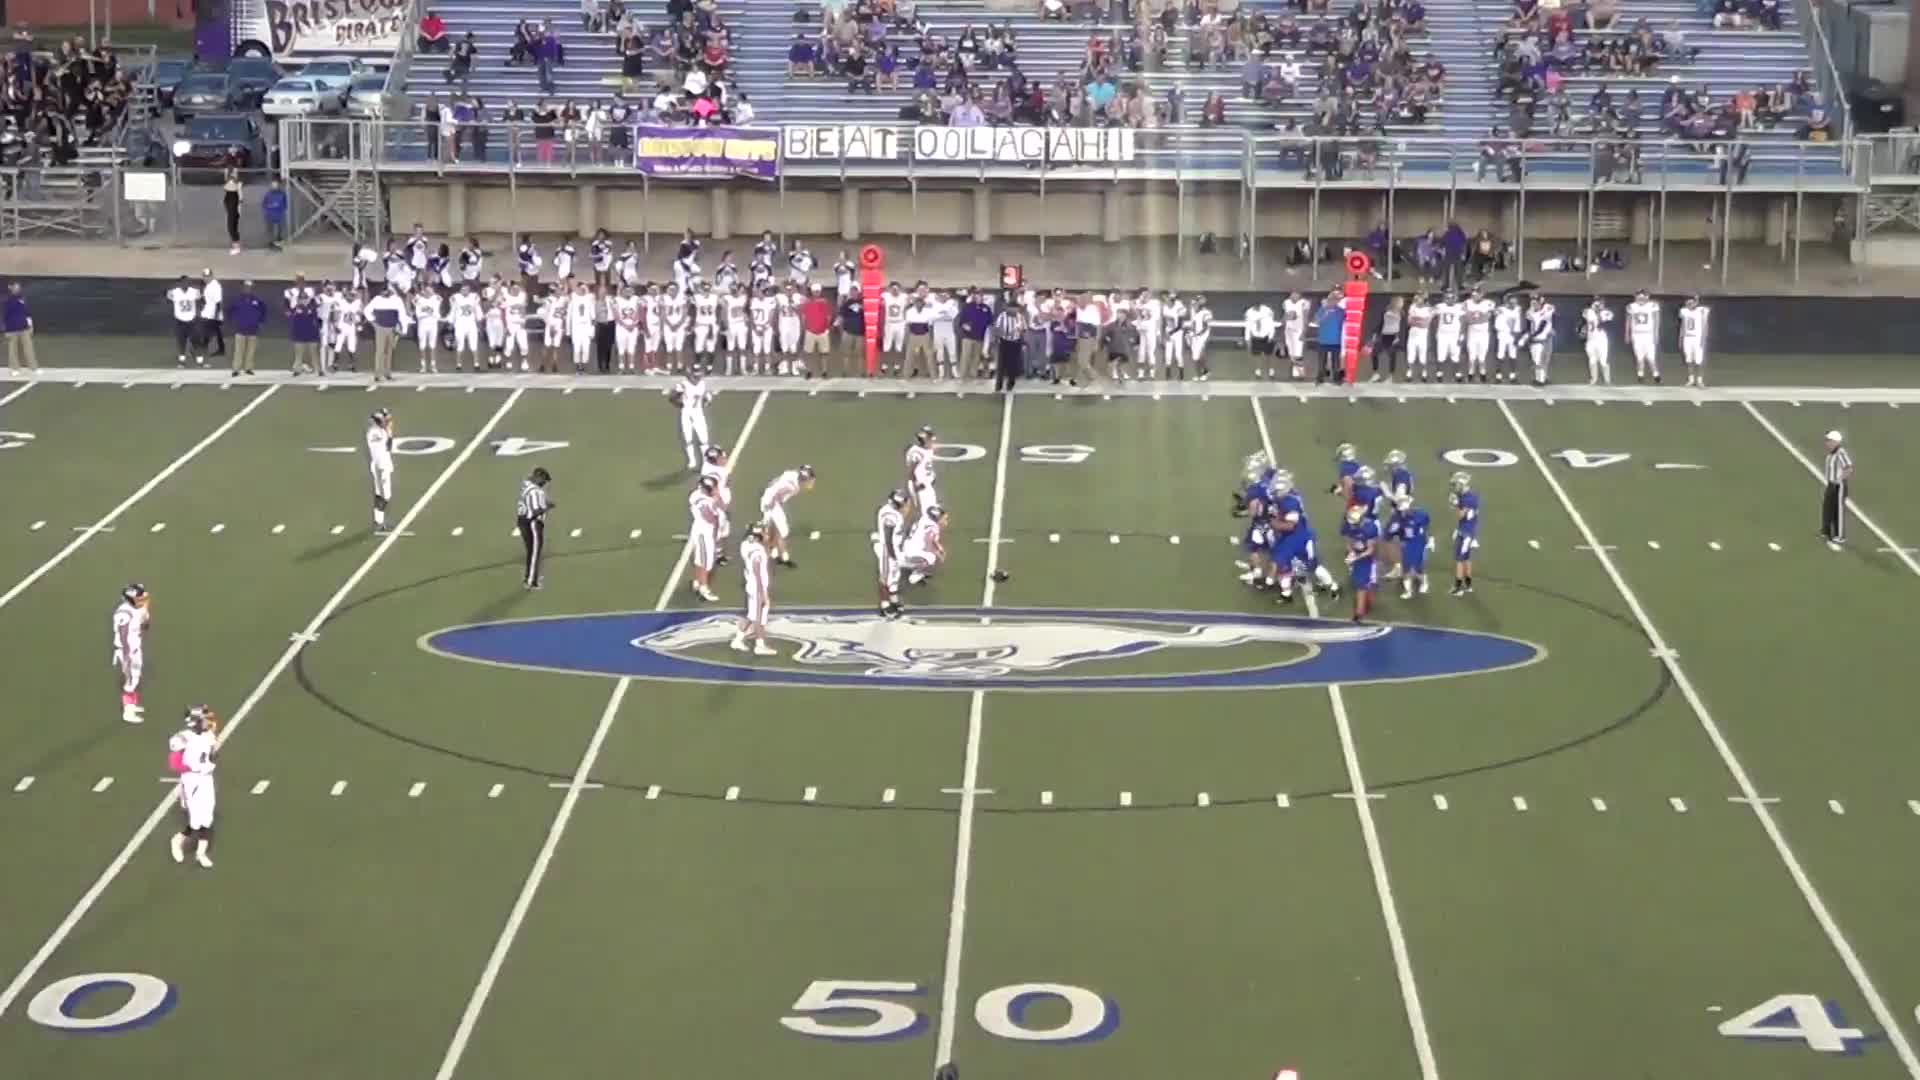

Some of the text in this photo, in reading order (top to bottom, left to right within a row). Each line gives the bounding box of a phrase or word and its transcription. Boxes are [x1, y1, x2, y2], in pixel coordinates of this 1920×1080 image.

[336, 15, 407, 43] PIRATE
[790, 127, 897, 157] BEAT
[779, 980, 1114, 1041] 50
